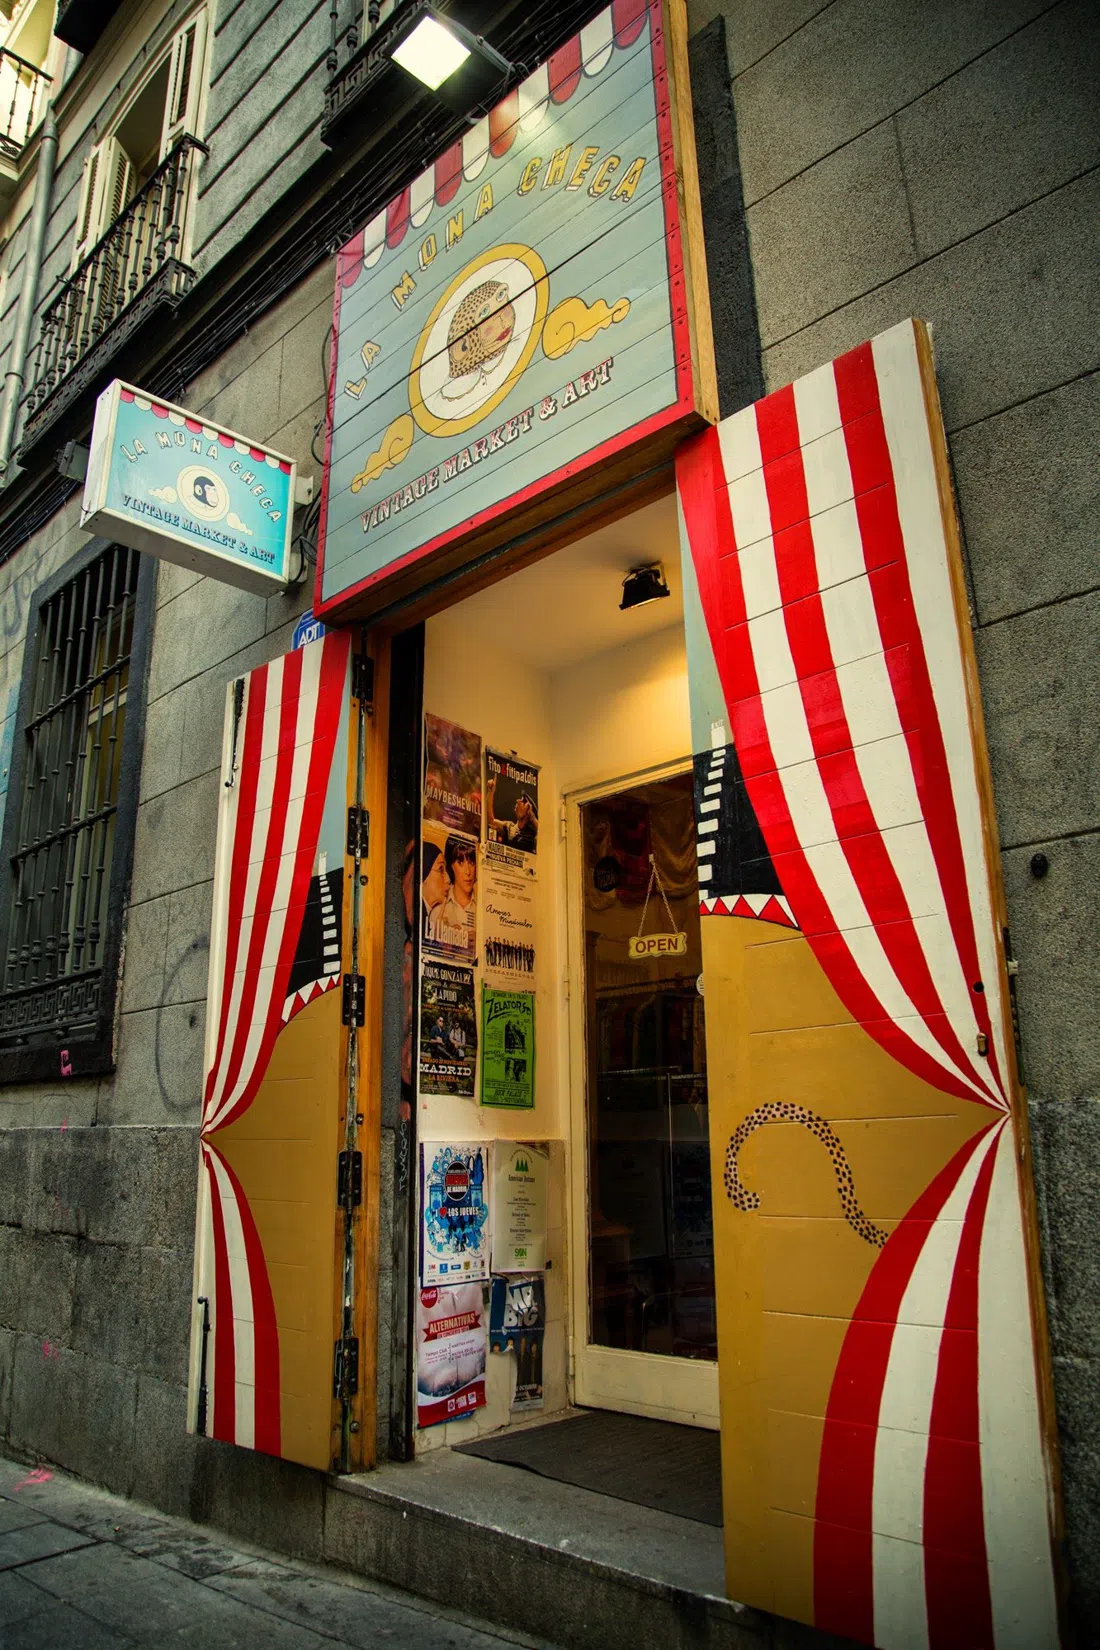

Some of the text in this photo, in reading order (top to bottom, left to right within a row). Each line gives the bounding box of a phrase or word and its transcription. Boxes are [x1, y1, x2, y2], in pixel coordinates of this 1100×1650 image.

[344, 144, 647, 400] LA MONA CHECA
[360, 356, 615, 533] VINTAGE MARKET & ART
[120, 431, 282, 523] LA MONA CHECA
[121, 493, 275, 564] VINTAGE MARKET & ART
[300, 622, 320, 646] ADT
[425, 786, 482, 816] MAYBESHEWILL
[635, 938, 678, 953] OPEN
[420, 1063, 471, 1076] MADRID
[429, 1312, 476, 1335] ALTERNATIVAS
